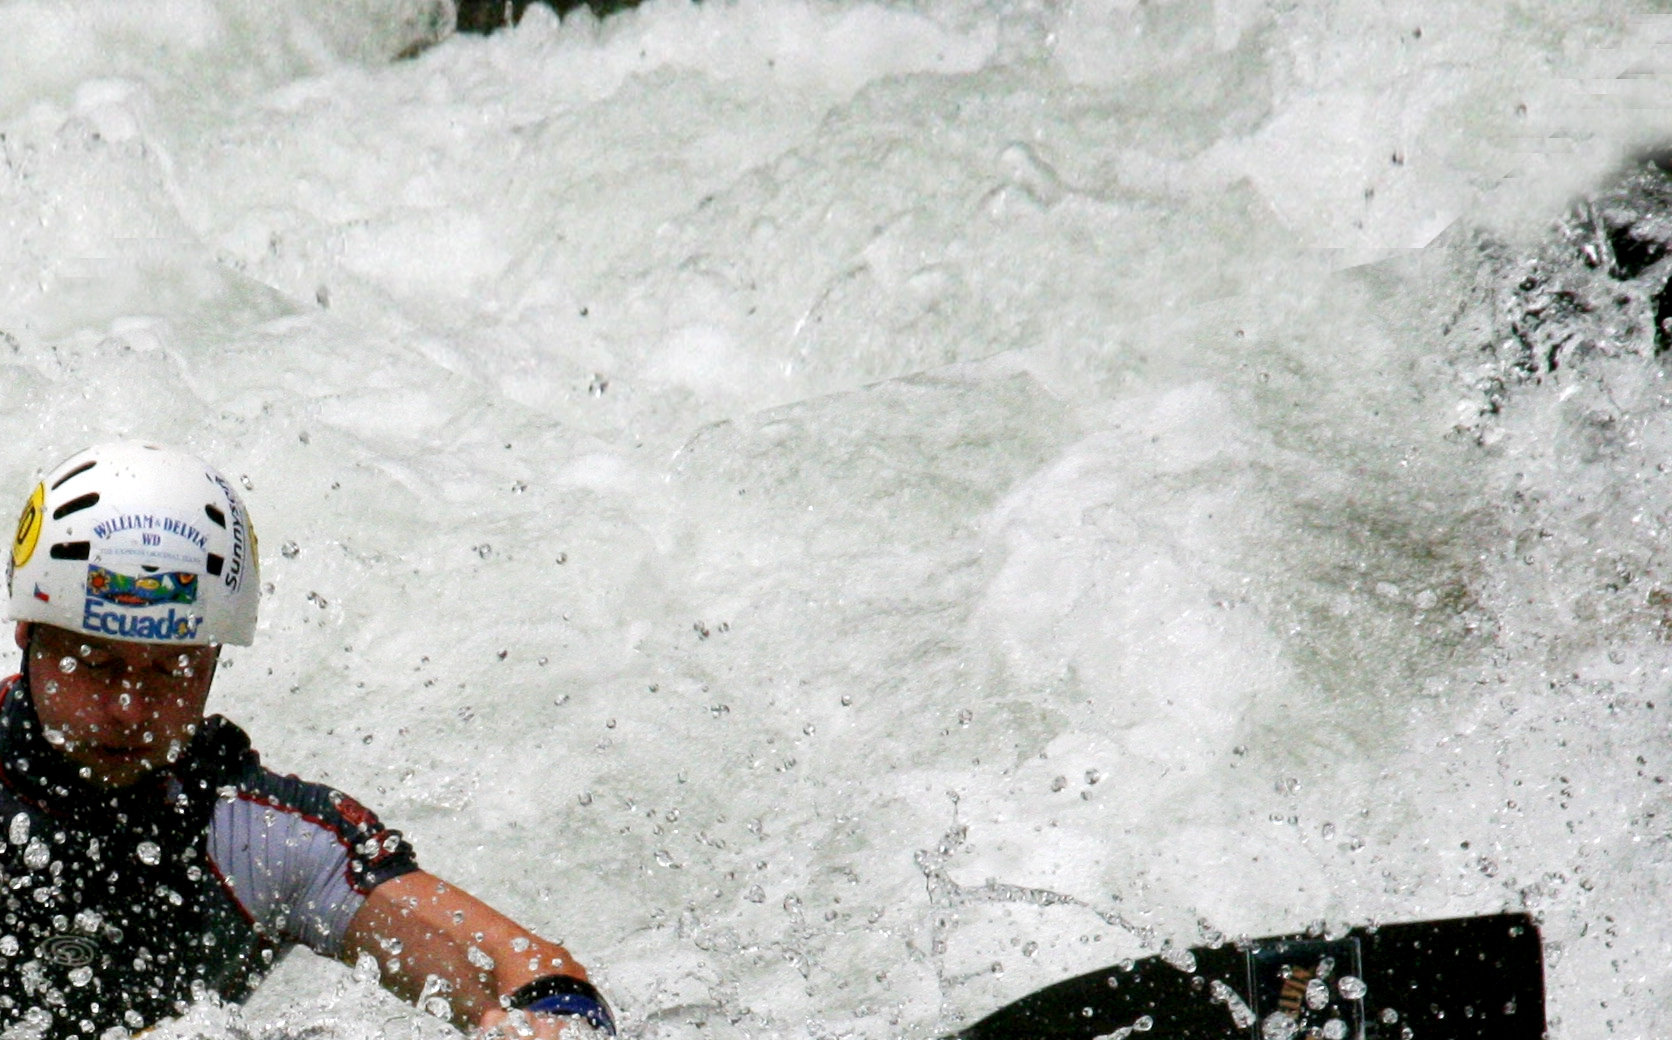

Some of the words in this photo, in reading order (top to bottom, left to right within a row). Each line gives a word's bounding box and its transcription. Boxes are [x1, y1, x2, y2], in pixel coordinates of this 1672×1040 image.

[93, 515, 153, 539] WILLIAM
[142, 532, 161, 546] WD
[82, 599, 203, 639] Ecuador
